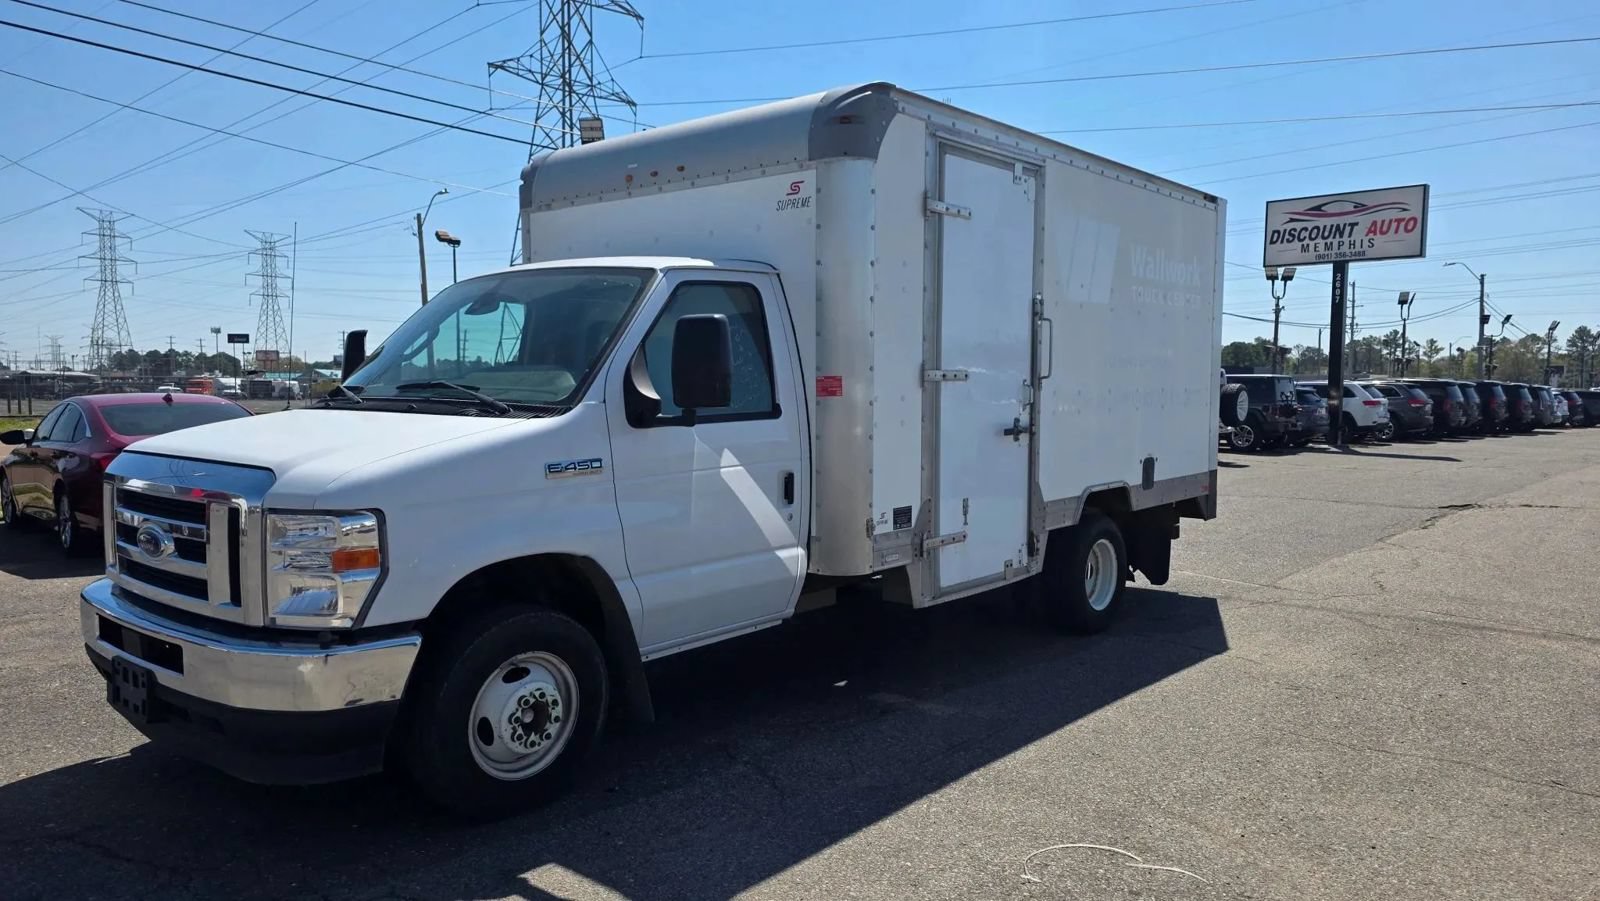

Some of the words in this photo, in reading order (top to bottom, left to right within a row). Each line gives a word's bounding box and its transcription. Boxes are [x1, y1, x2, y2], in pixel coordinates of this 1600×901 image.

[776, 196, 812, 212] SUPREME
[1269, 222, 1359, 245] DISCOUNT
[1365, 216, 1419, 237] AUTO
[1300, 238, 1375, 254] MEMPHIS
[1315, 252, 1333, 261] (901)
[1129, 242, 1201, 288] Wallwork
